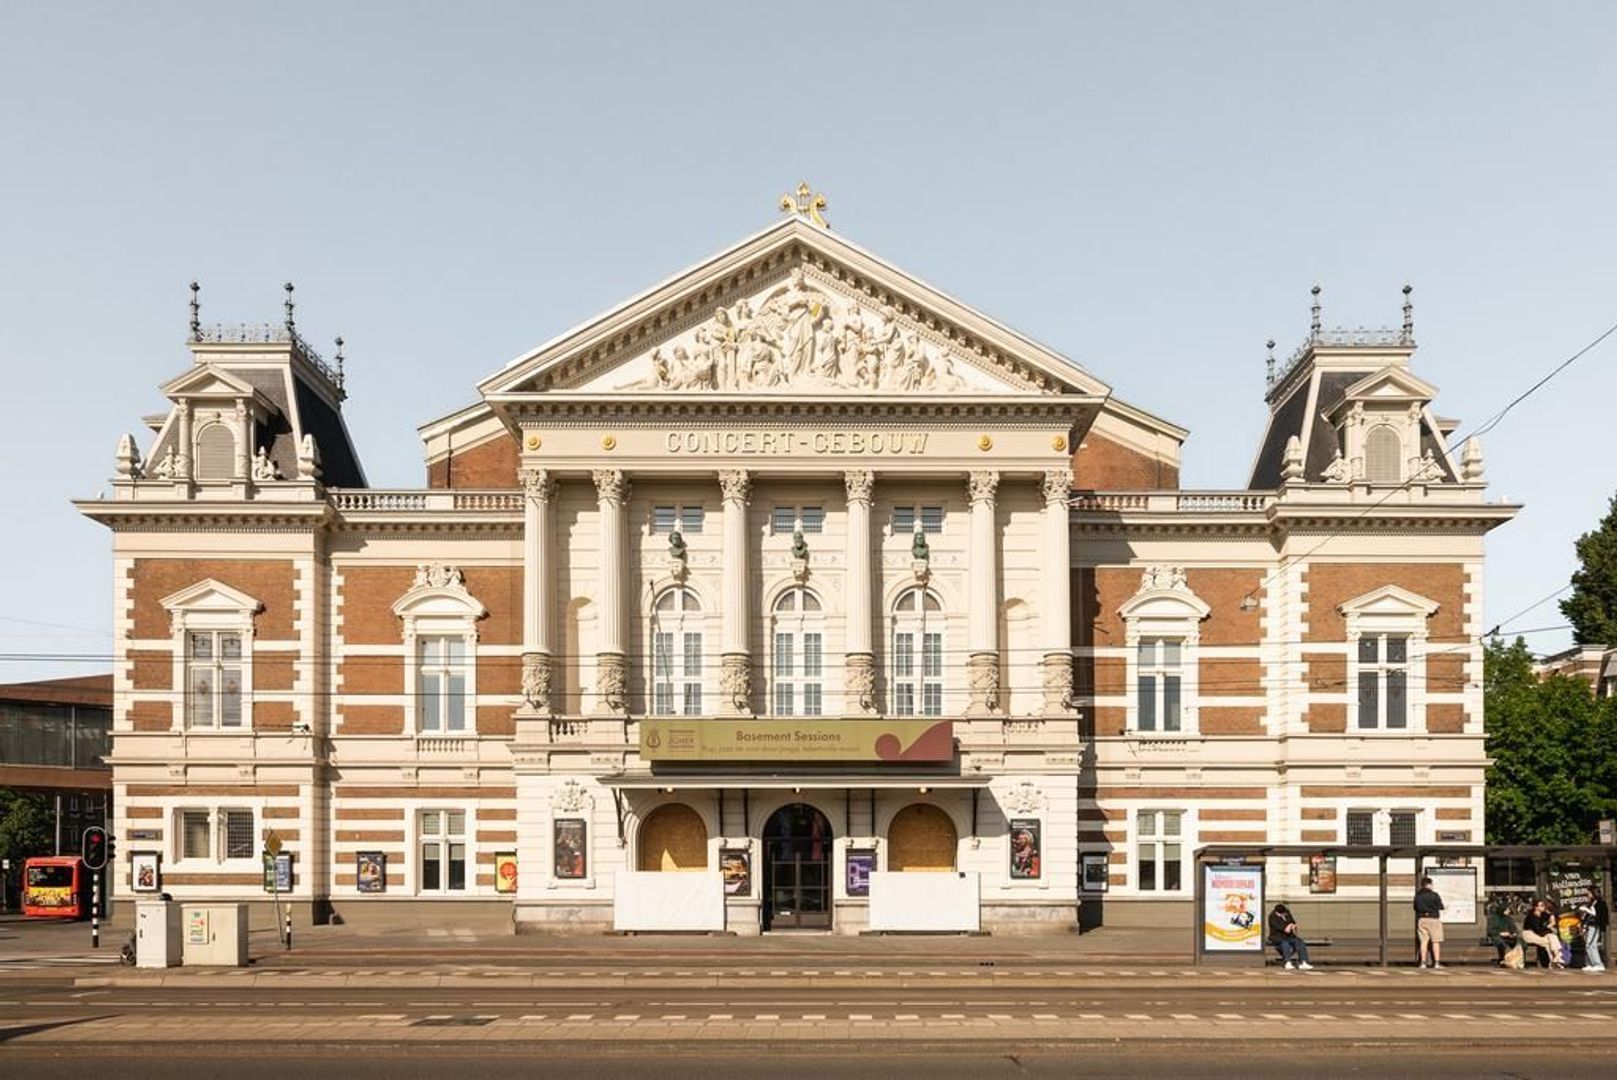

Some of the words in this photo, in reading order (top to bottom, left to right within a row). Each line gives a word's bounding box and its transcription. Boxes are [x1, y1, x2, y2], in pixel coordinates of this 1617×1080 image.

[667, 432, 930, 454] CONCERT-GEBOUW
[735, 730, 791, 742] Basement
[794, 730, 841, 742] Sessions
